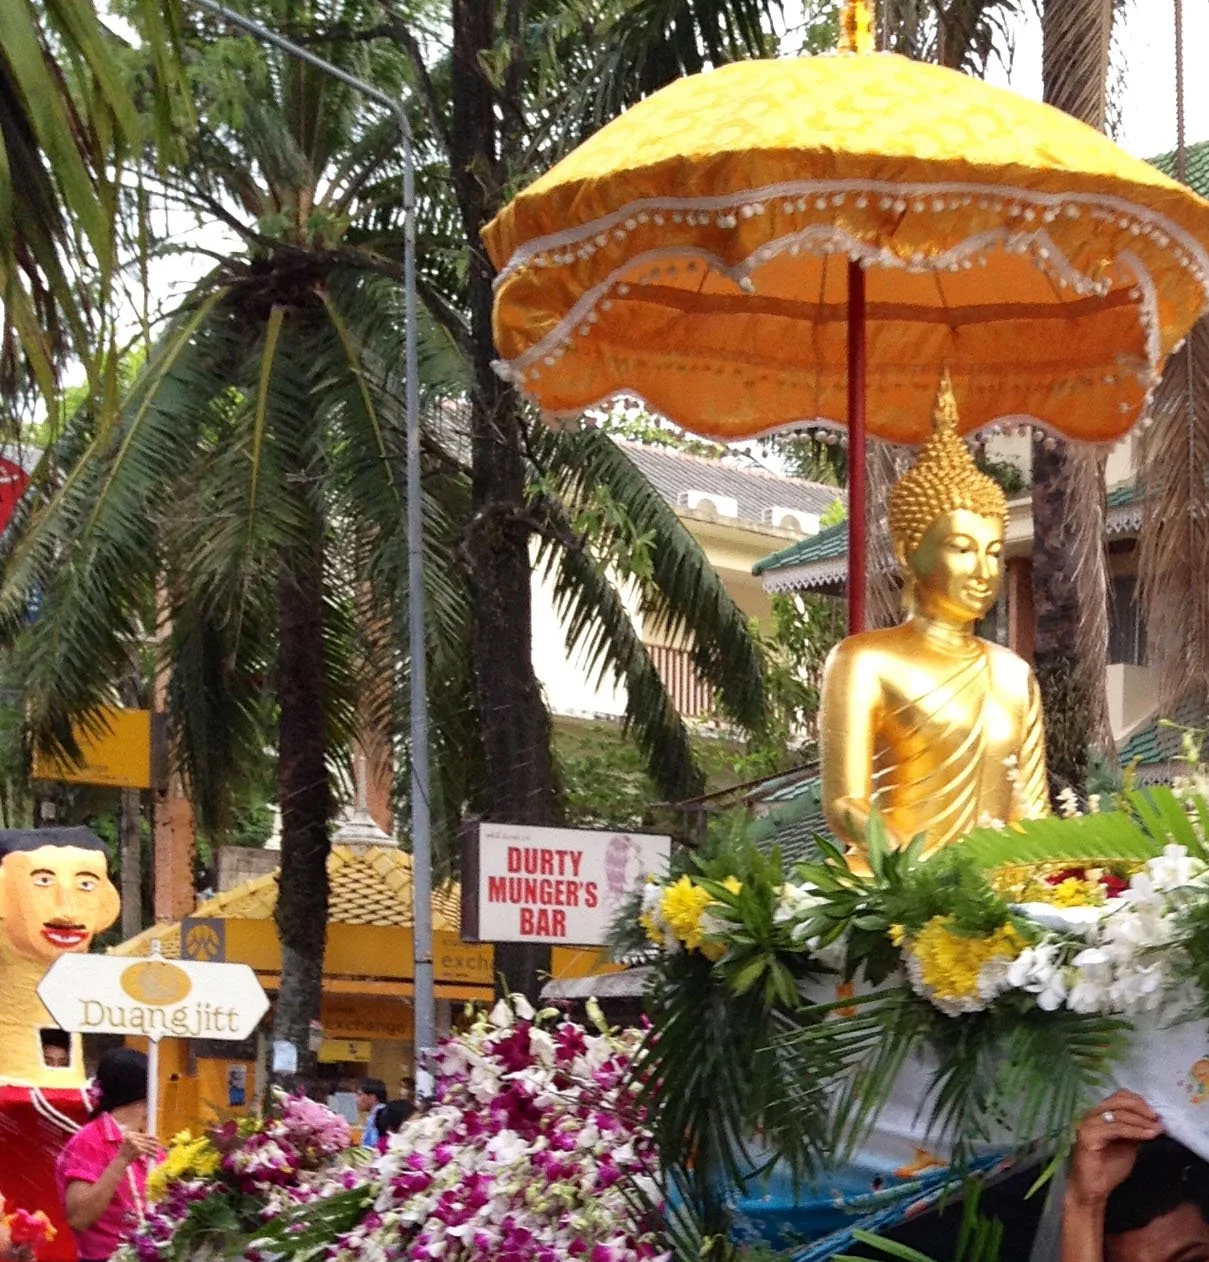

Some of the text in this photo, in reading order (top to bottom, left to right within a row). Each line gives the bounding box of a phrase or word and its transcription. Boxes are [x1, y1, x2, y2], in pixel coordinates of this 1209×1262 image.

[507, 846, 584, 878] DURTY
[488, 876, 599, 909] MUNGER'S
[519, 907, 567, 938] BAR
